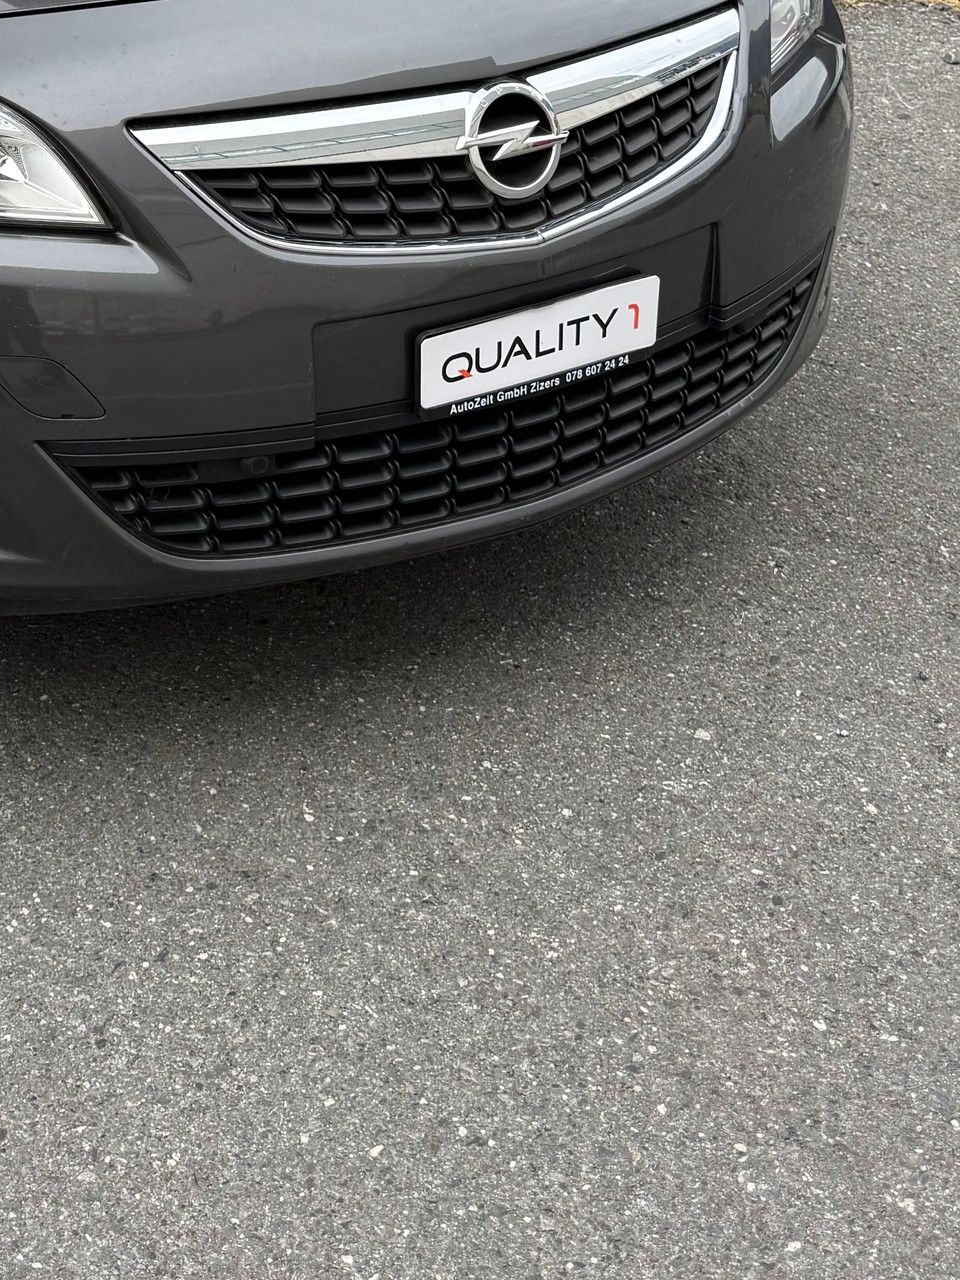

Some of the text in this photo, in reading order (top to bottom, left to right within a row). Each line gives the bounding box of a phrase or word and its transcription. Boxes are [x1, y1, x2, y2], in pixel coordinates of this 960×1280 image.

[441, 303, 640, 383] QUALITY 1
[450, 354, 630, 415] AutoZeit GmbH Zizers 078 607 24 24
